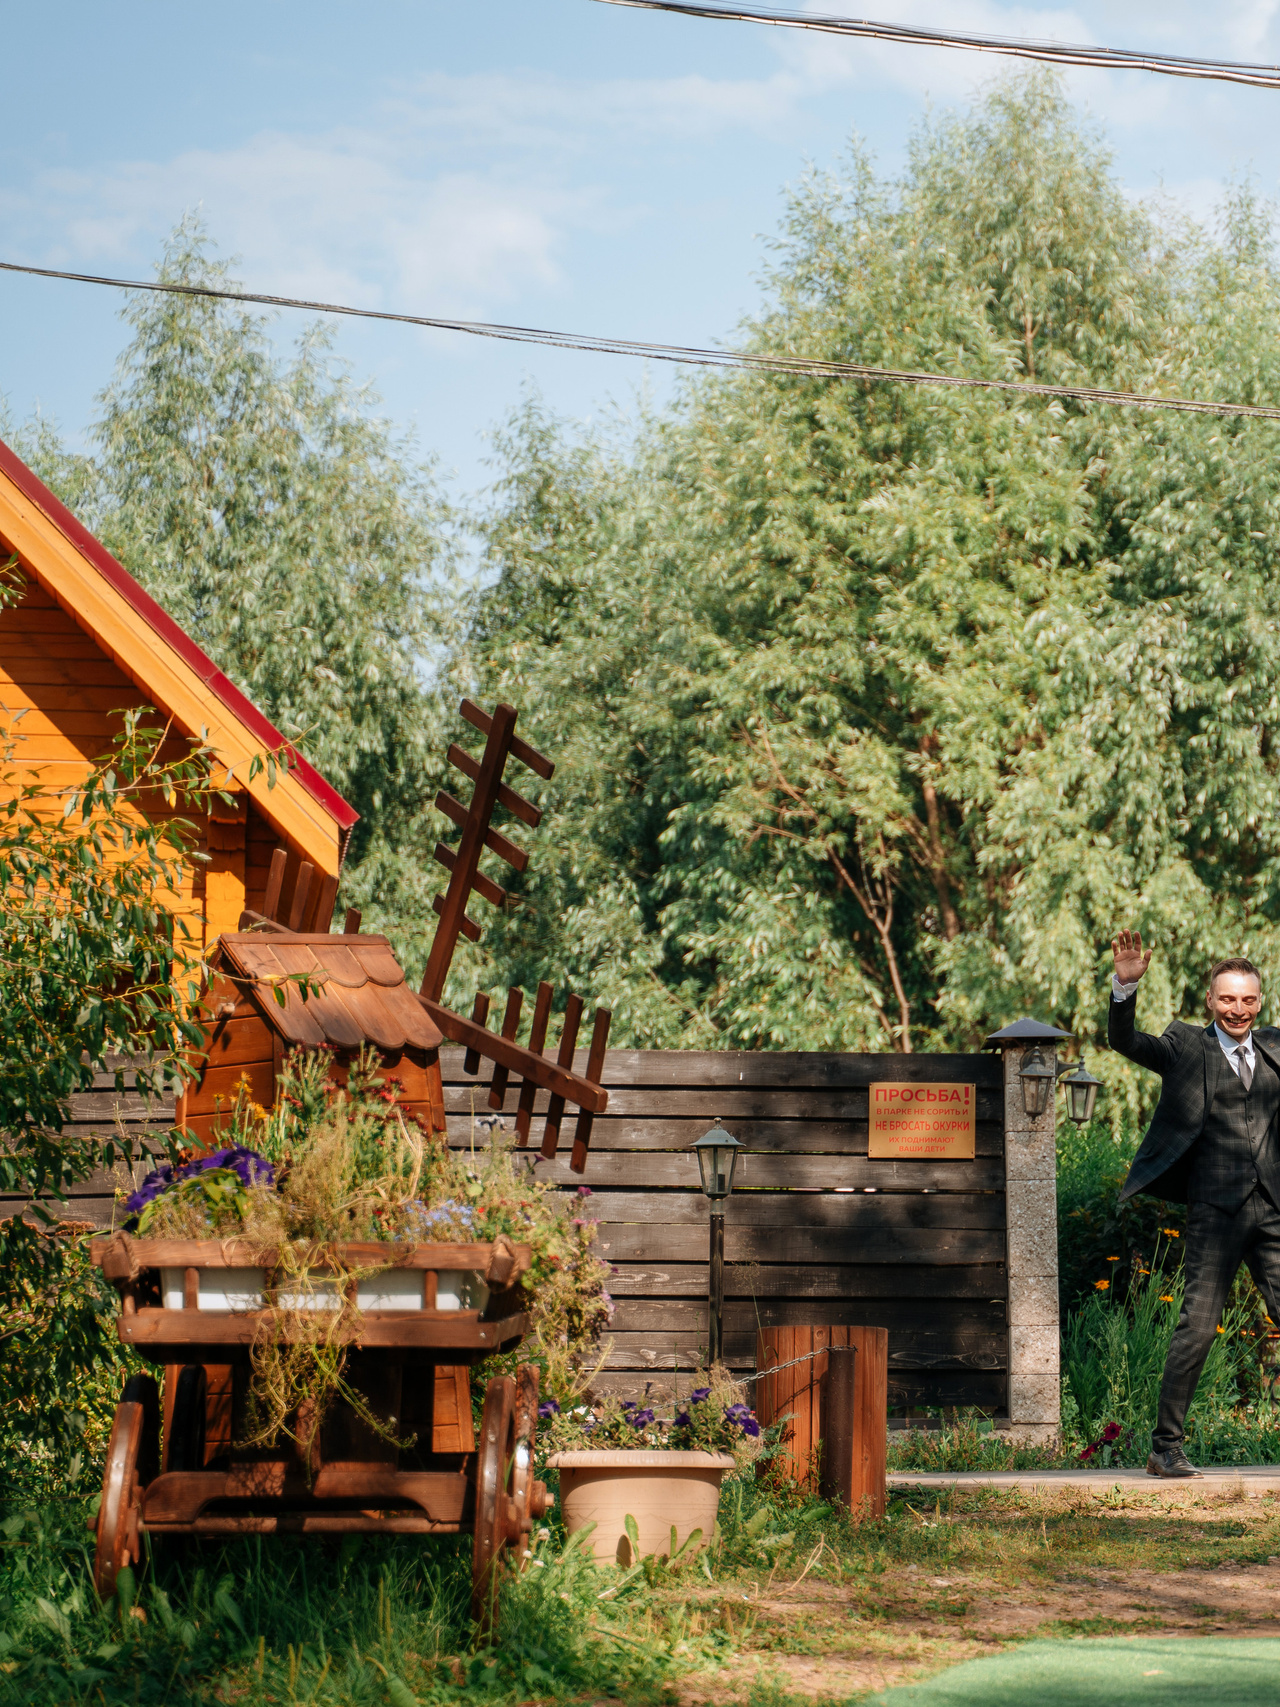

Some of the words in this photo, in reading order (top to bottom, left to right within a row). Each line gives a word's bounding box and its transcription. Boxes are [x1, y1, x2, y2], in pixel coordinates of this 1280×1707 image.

[875, 1086, 970, 1105] ПРОСЬБА!
[883, 1108, 912, 1116] ПАРКЕ
[926, 1108, 960, 1116] СОРИТЬ
[962, 1108, 969, 1116] И
[875, 1120, 887, 1131] НЕ
[889, 1120, 931, 1131] БРОСАТЬ
[932, 1120, 970, 1131] ОКУРКИ
[901, 1136, 955, 1144] ПОДНИМАЮТ
[924, 1145, 946, 1153] ДЕТИ
